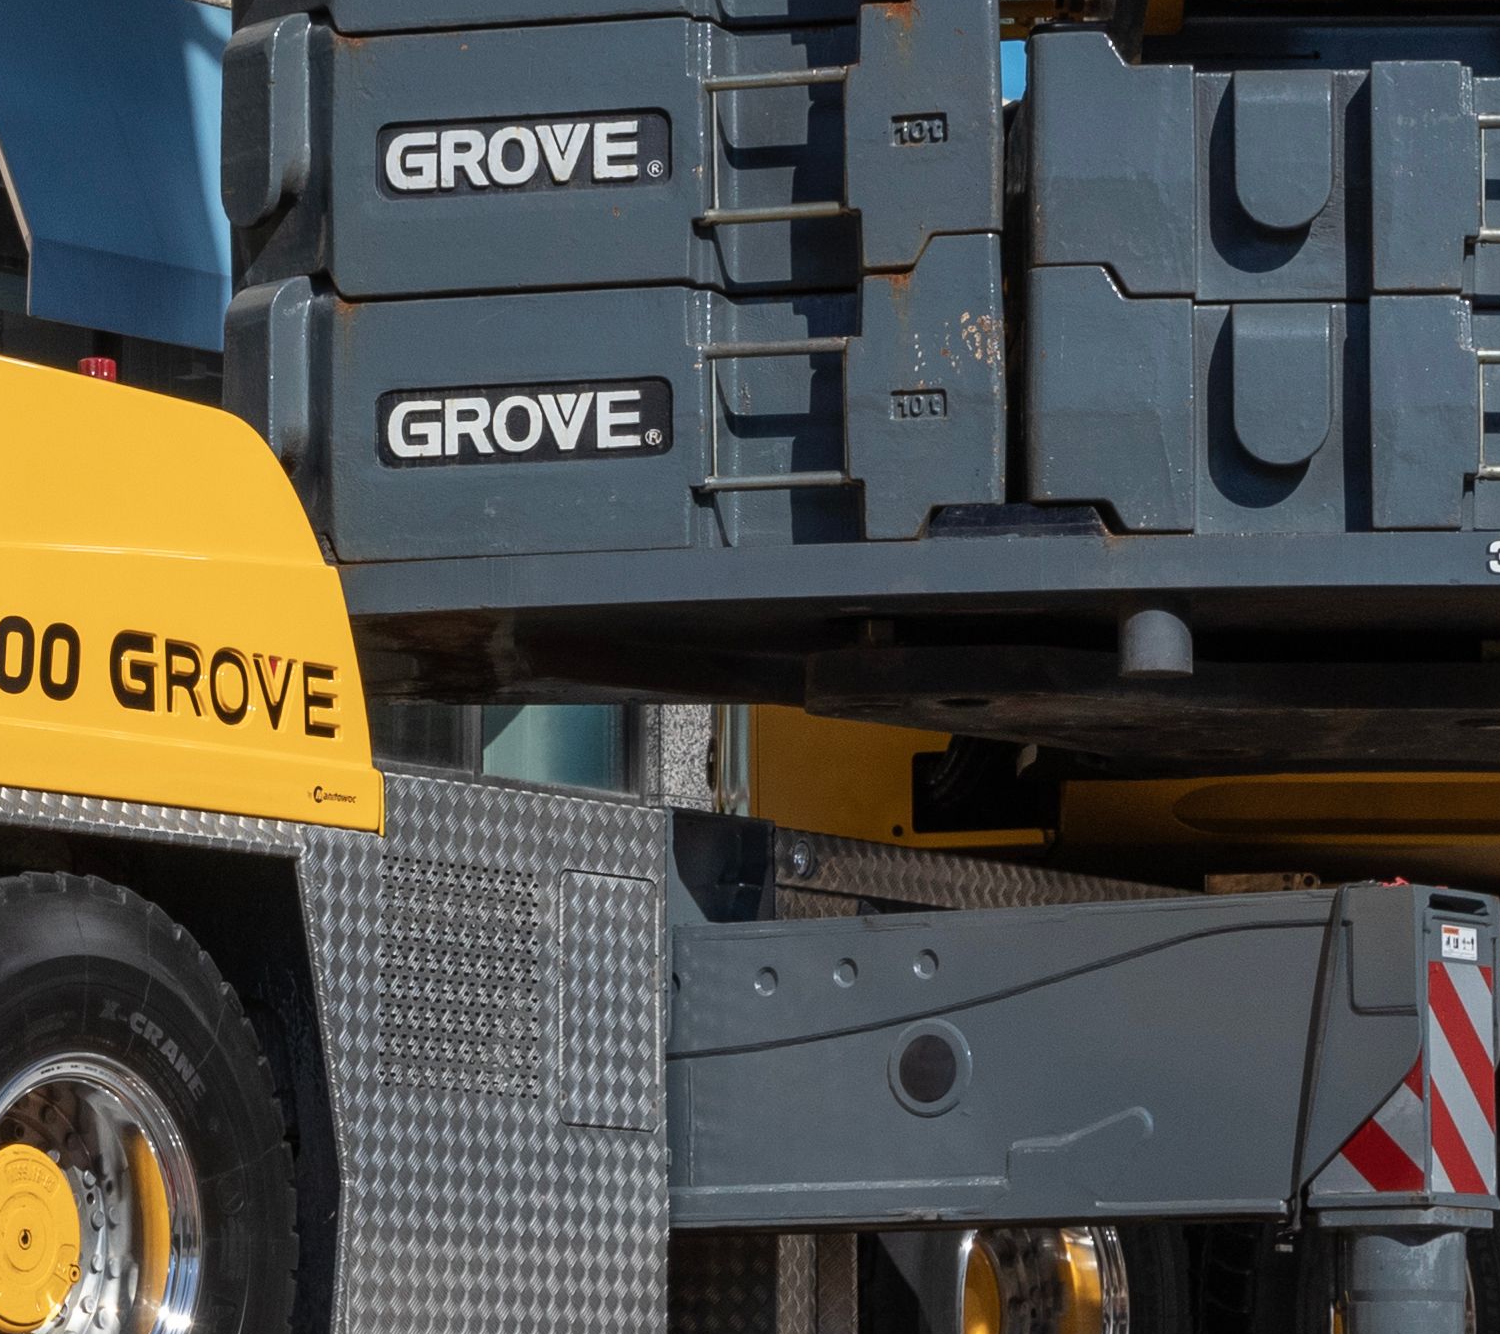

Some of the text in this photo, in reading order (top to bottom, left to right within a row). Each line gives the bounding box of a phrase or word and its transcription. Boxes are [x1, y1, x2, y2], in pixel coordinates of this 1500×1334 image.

[385, 120, 638, 192] GROVE
[388, 390, 641, 458] GROVE
[110, 629, 342, 741] GROVE
